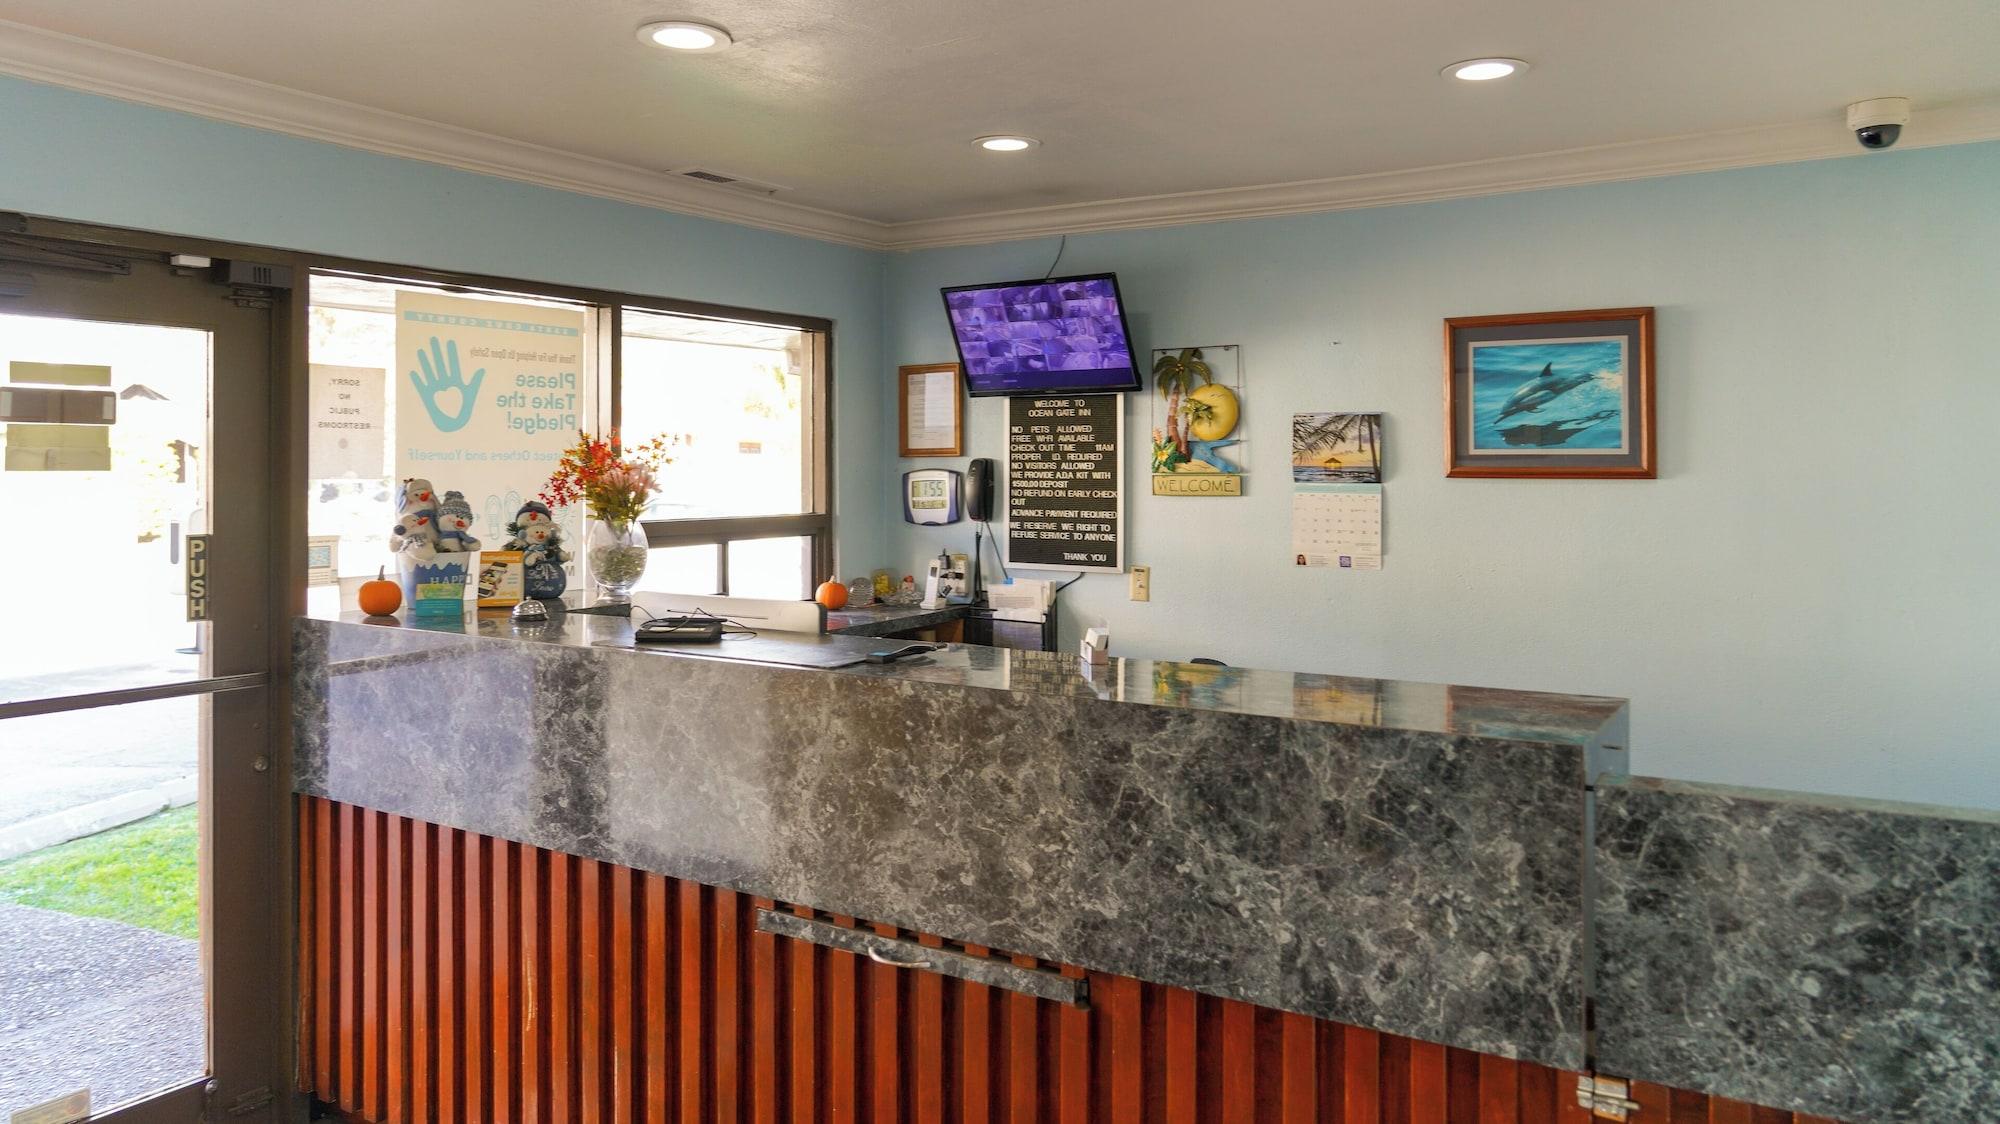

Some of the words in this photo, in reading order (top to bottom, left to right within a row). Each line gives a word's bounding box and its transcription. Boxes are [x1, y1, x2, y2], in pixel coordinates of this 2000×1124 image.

[1034, 400, 1069, 408] WELCOME
[1075, 399, 1085, 407] TO
[1028, 409, 1053, 417] OCEAN
[1056, 409, 1075, 417] GATE
[1011, 426, 1023, 434] NO
[1030, 425, 1050, 433] PETS
[1056, 425, 1093, 433] ALLOWED
[1011, 435, 1031, 443] FREE
[1057, 434, 1095, 442] AVAILABLE
[1010, 444, 1036, 452] CHECK
[1058, 443, 1076, 451] TIME
[1011, 453, 1041, 461] PROPER
[1067, 452, 1103, 461] REQUIRED
[1011, 462, 1023, 470] NO
[1025, 462, 1057, 470] VISITORS
[1060, 462, 1095, 470] ALLOWED
[1010, 471, 1022, 479] WE
[1024, 471, 1054, 479] PROVIDE
[1076, 471, 1088, 479] KIT
[1092, 471, 1111, 479] WITH
[1039, 480, 1069, 488] DEPOSIT
[1157, 479, 1235, 493] WELCOME
[1011, 489, 1022, 497] NO
[1023, 489, 1053, 497] REFUND
[1067, 490, 1091, 498] EARLY
[1092, 490, 1118, 499] CHECK
[1011, 498, 1025, 506] OUT
[1011, 509, 1044, 517] ADVANCE
[1045, 510, 1080, 518] PAYMENT
[1080, 510, 1117, 519] REQUIRED
[1009, 521, 1021, 529] WE
[1023, 522, 1057, 530] RESERVE
[1061, 523, 1074, 531] WE
[1076, 523, 1098, 531] RIGHT
[1099, 524, 1111, 532] TO
[1011, 531, 1038, 539] REFUSE
[1040, 532, 1070, 540] SERVICE
[1072, 532, 1083, 540] TO
[1084, 533, 1116, 541] ANYONE
[1063, 552, 1088, 561] THANK
[1090, 553, 1107, 562] YOU
[190, 539, 206, 619] PUSH
